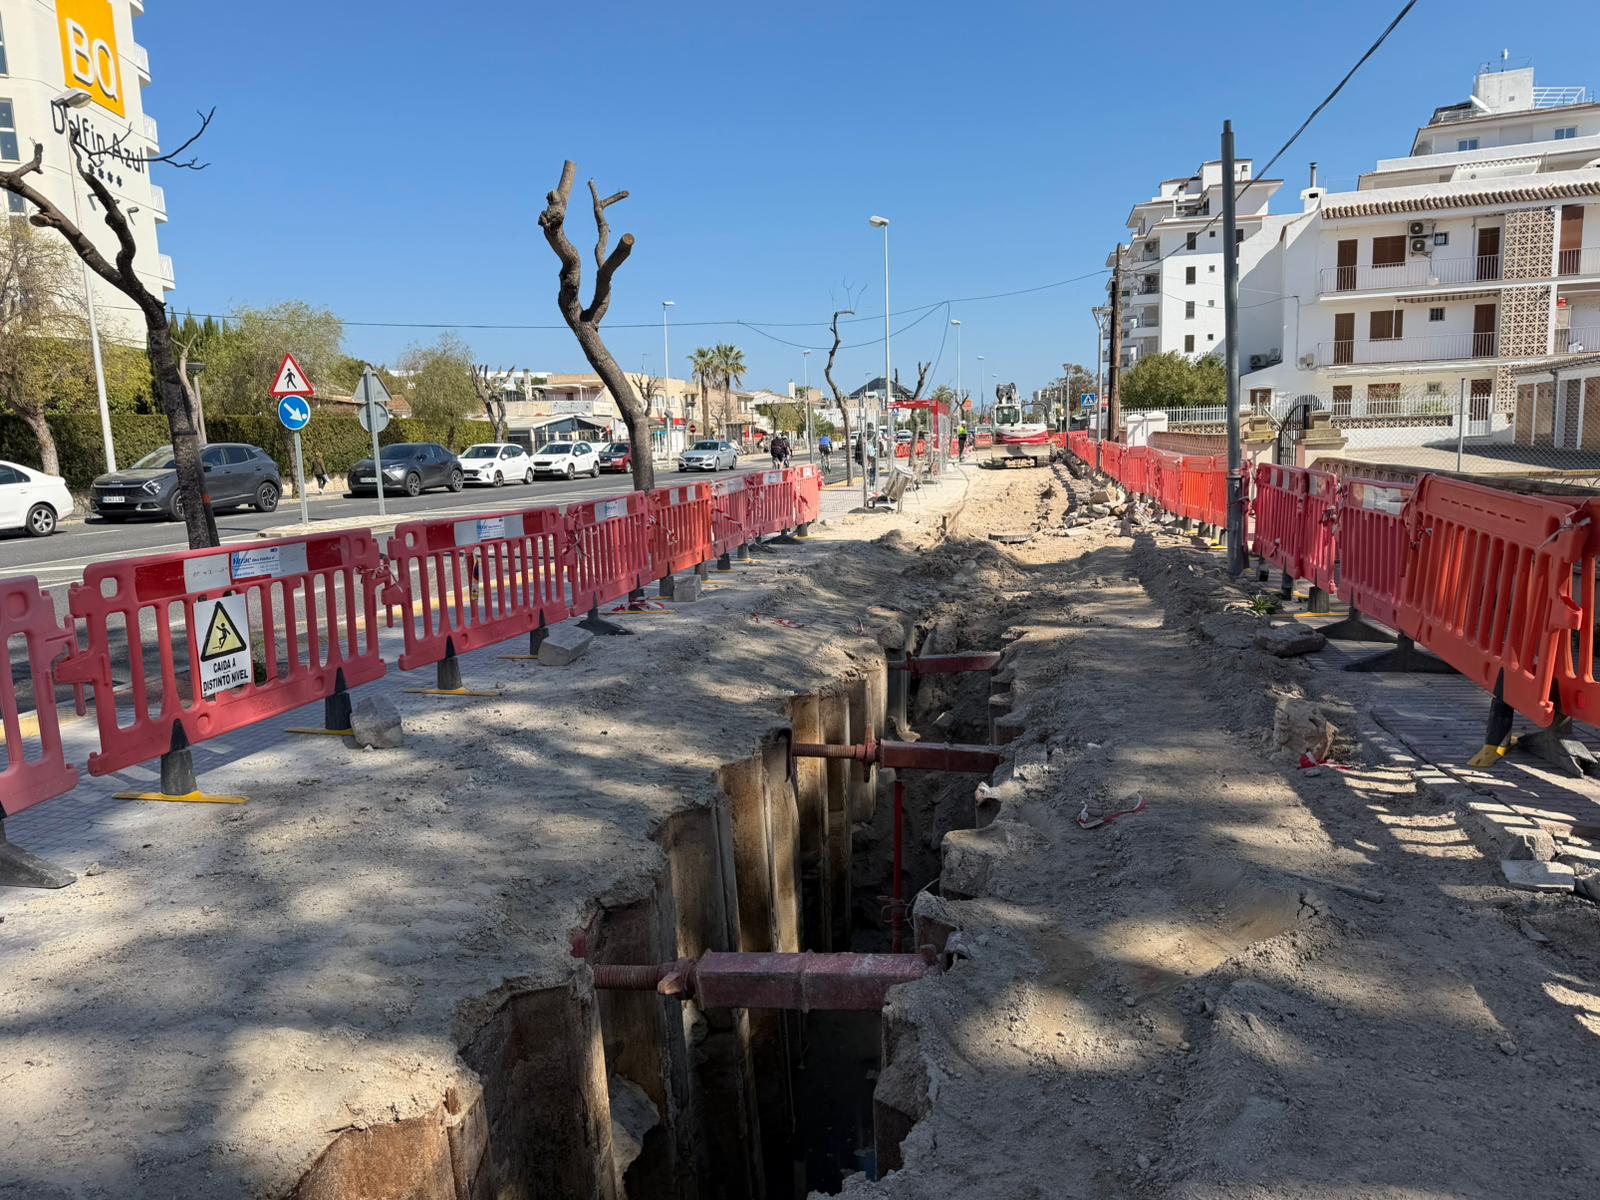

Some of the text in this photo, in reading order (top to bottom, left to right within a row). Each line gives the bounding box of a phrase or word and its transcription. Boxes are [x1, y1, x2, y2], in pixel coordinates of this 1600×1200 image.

[66, 17, 118, 102] BQ
[112, 132, 145, 174] Azul
[231, 657, 237, 668] A
[203, 669, 249, 691] DISTINTO NIVEL
